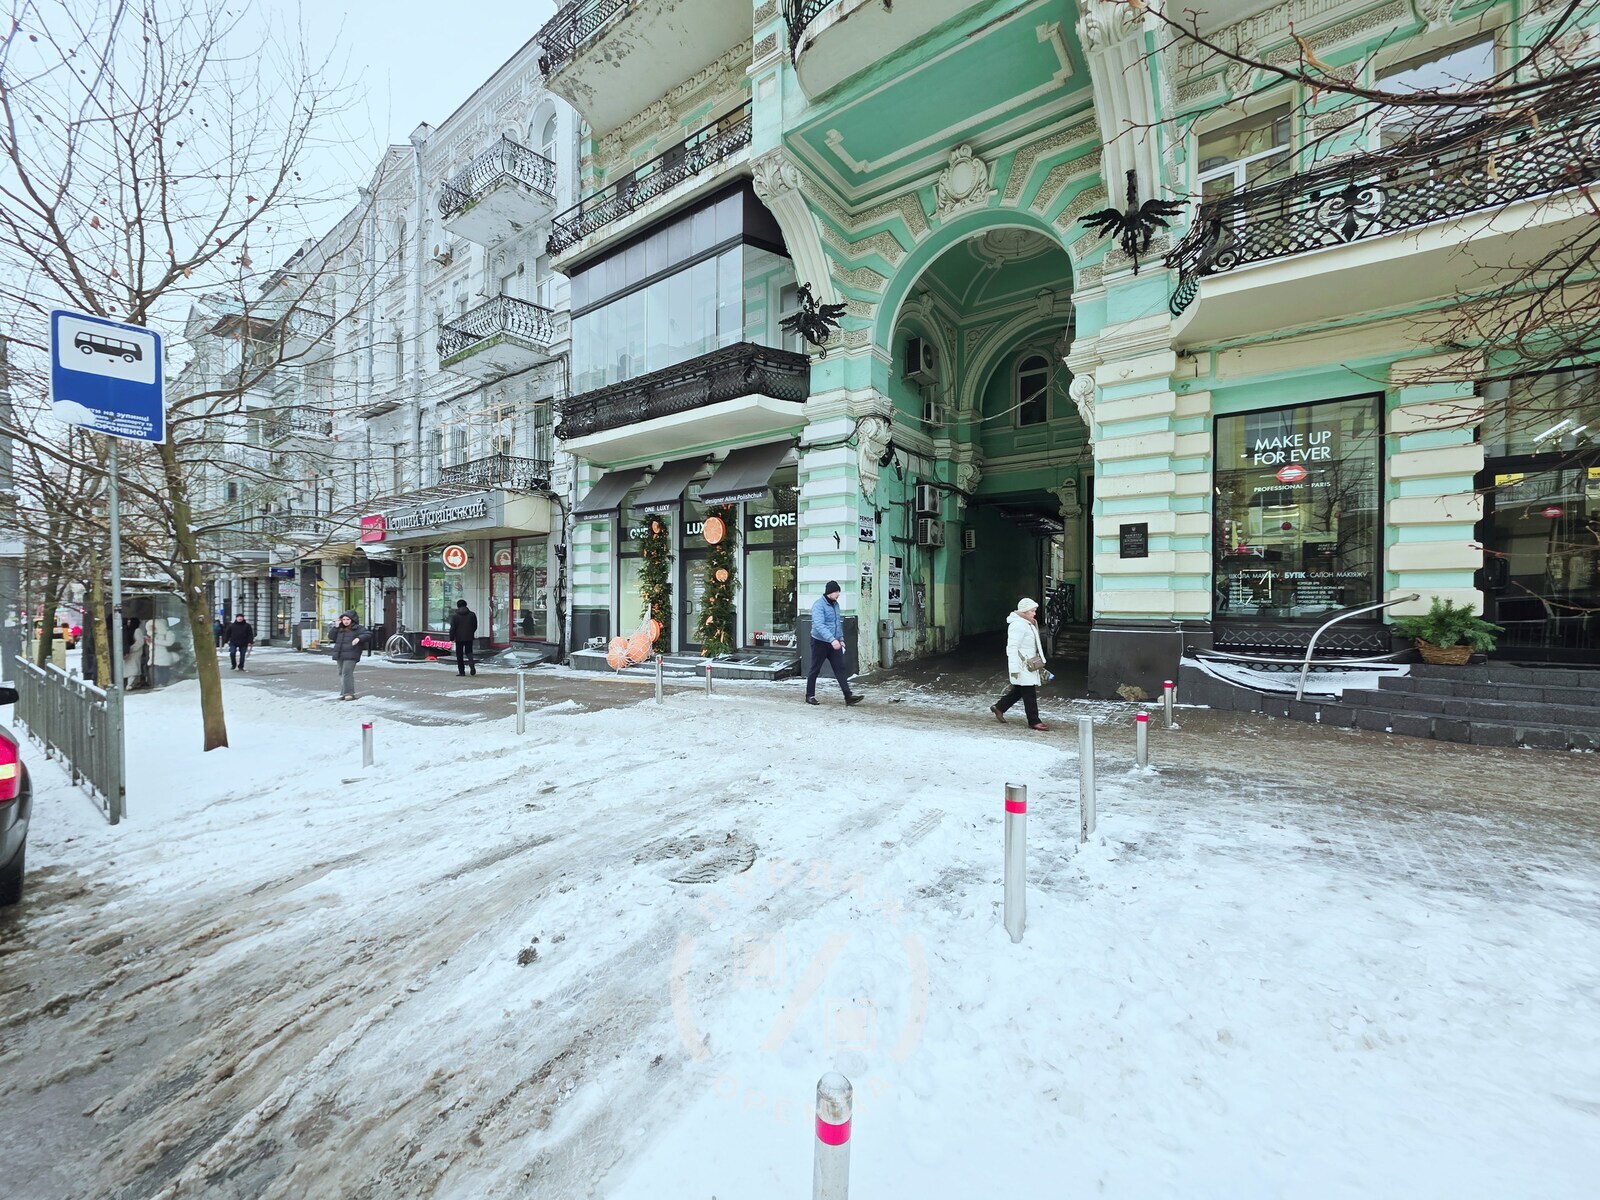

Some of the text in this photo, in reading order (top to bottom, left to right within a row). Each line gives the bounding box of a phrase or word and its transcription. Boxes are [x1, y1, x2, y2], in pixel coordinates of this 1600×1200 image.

[116, 412, 150, 422] зупинці
[95, 422, 147, 437] ОРОНЕНО!
[1254, 431, 1332, 451] MAKE UP
[1254, 446, 1331, 466] FOR EVER
[1253, 484, 1304, 493] PROFESSIONAL
[704, 497, 725, 505] designer
[736, 491, 763, 500] Polishchuk
[686, 522, 705, 535] LUX
[754, 513, 796, 529] STORE
[1284, 571, 1306, 579] БУТІК
